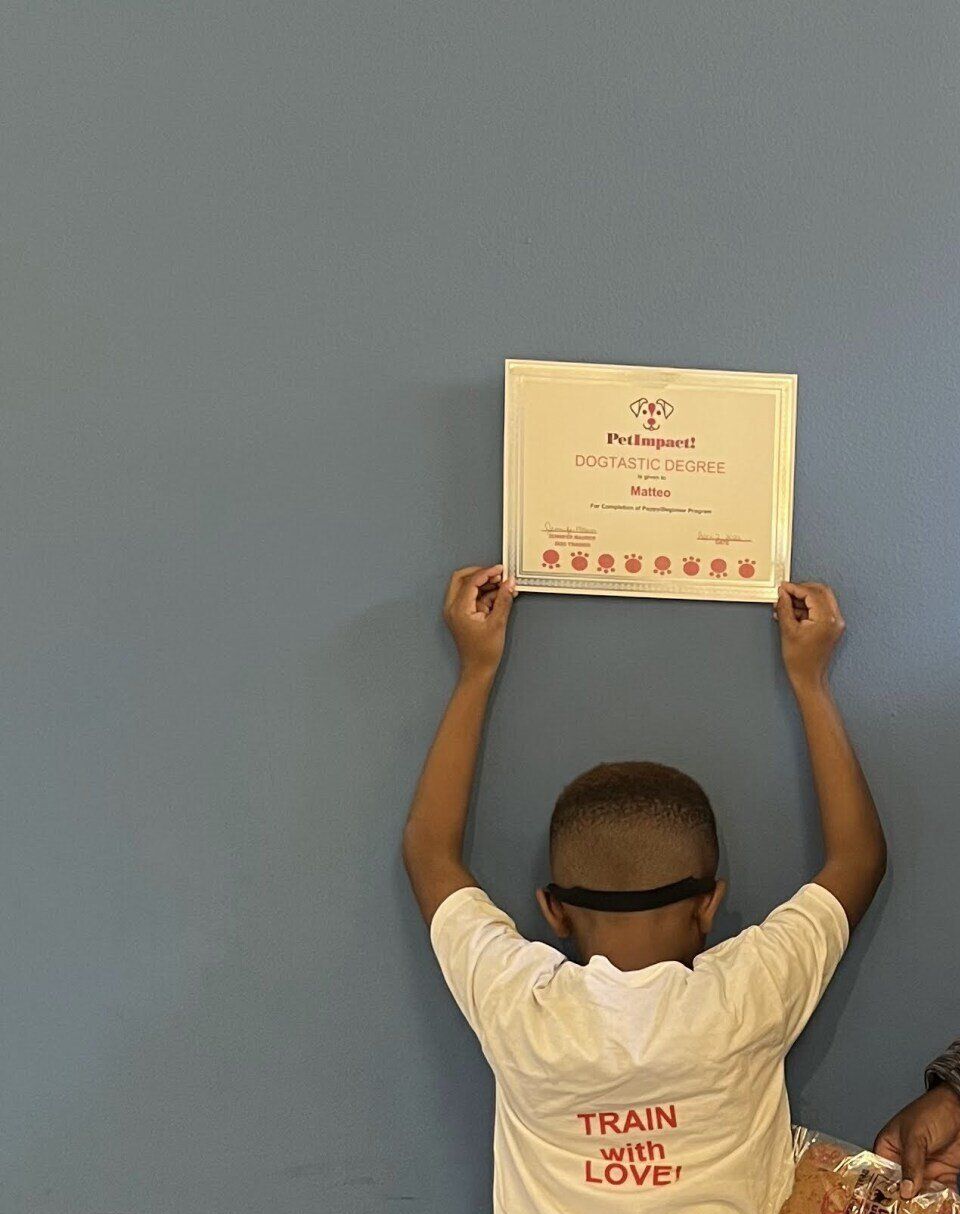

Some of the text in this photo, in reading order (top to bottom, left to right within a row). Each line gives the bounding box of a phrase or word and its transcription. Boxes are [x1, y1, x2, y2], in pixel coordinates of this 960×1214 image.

[607, 432, 696, 450] PetImpact!
[575, 454, 726, 474] DOGTASTIC DEGREE
[630, 485, 671, 497] Matteo
[577, 1104, 678, 1136] TRAIN
[599, 1140, 666, 1163] with
[585, 1160, 682, 1186] LOVE!
